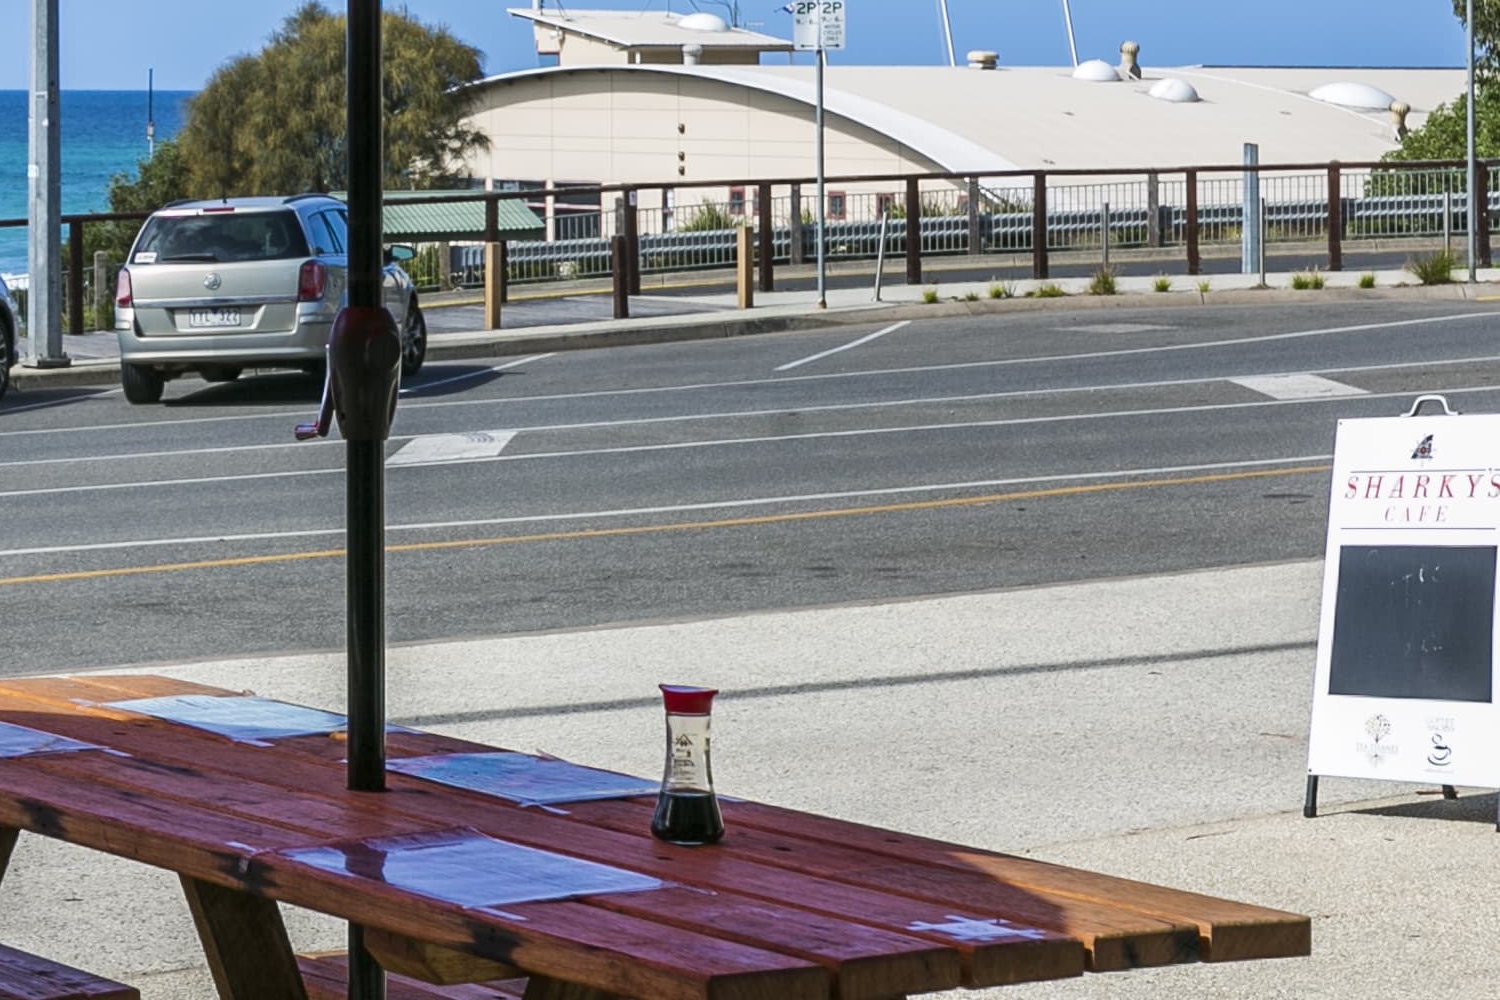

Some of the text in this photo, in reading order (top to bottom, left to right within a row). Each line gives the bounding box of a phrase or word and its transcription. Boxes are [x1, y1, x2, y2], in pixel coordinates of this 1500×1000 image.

[796, 2, 817, 15] 2P
[822, 1, 843, 14] 2P
[1384, 505, 1449, 522] CAFE
